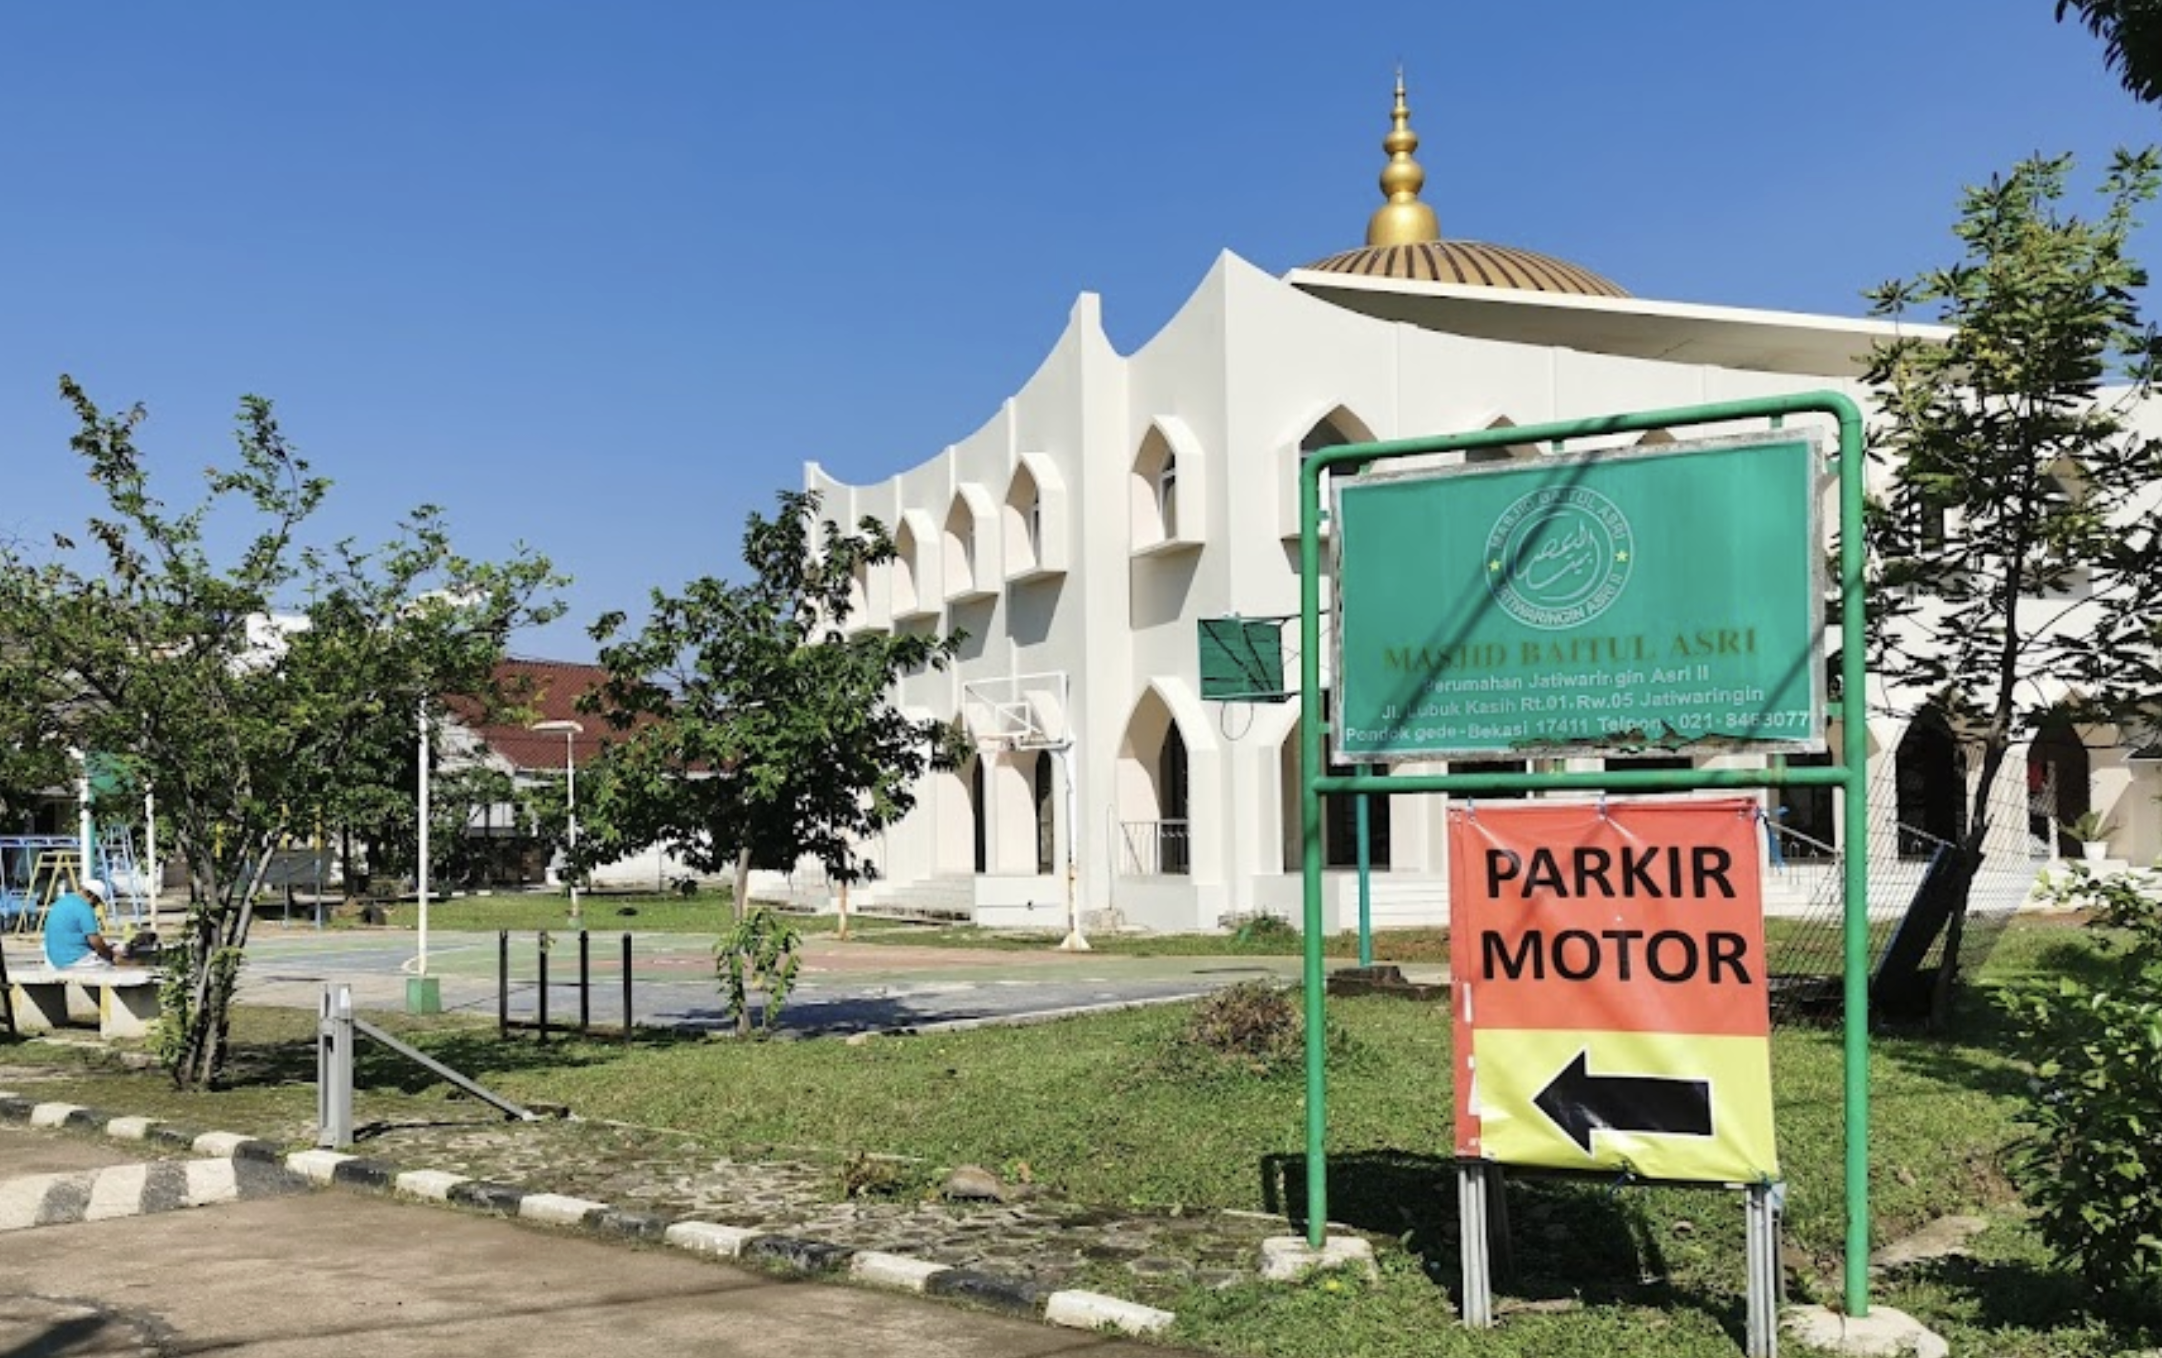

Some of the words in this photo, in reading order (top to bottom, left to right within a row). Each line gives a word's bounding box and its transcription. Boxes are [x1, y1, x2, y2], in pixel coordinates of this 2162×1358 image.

[1520, 635, 1656, 666] BAITUL
[1671, 628, 1756, 659] ASRI
[1650, 664, 1691, 683] Asri
[1382, 705, 1400, 720] Jl.
[1465, 698, 1516, 715] Kasih
[1640, 685, 1765, 706] Jatiwaringin
[1346, 725, 1411, 741] Pondok
[1536, 718, 1588, 735] 17411
[1485, 846, 1736, 898] PARKIR
[1481, 929, 1752, 984] MOTOR
